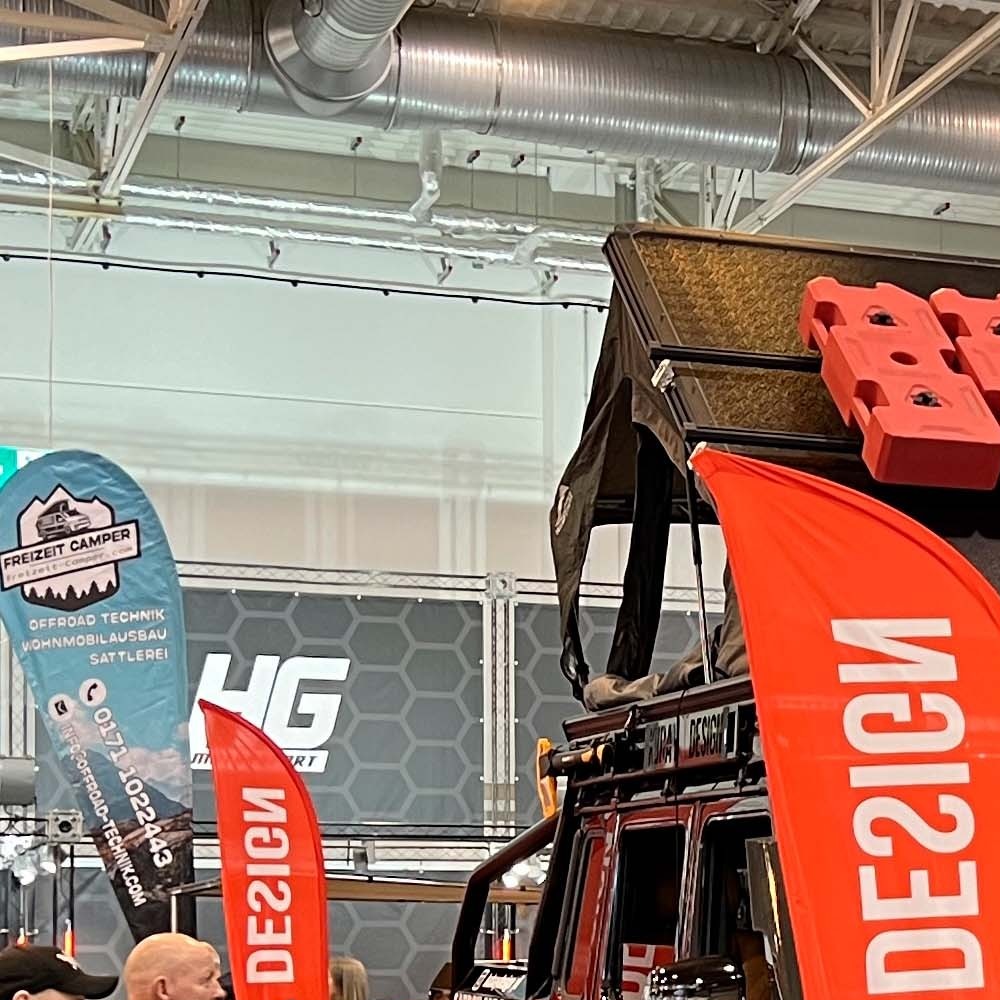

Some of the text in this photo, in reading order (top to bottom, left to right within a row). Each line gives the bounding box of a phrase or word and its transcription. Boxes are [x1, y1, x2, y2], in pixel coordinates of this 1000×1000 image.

[3, 528, 131, 570] FREIZEIT CAMPER
[29, 608, 165, 631] OFFROAD TECHNIK
[22, 628, 167, 652] WOHNMOBILAUSBAU
[90, 648, 168, 665] SATTLEREI
[189, 652, 350, 750] HG
[93, 707, 173, 869] 0171 1022443
